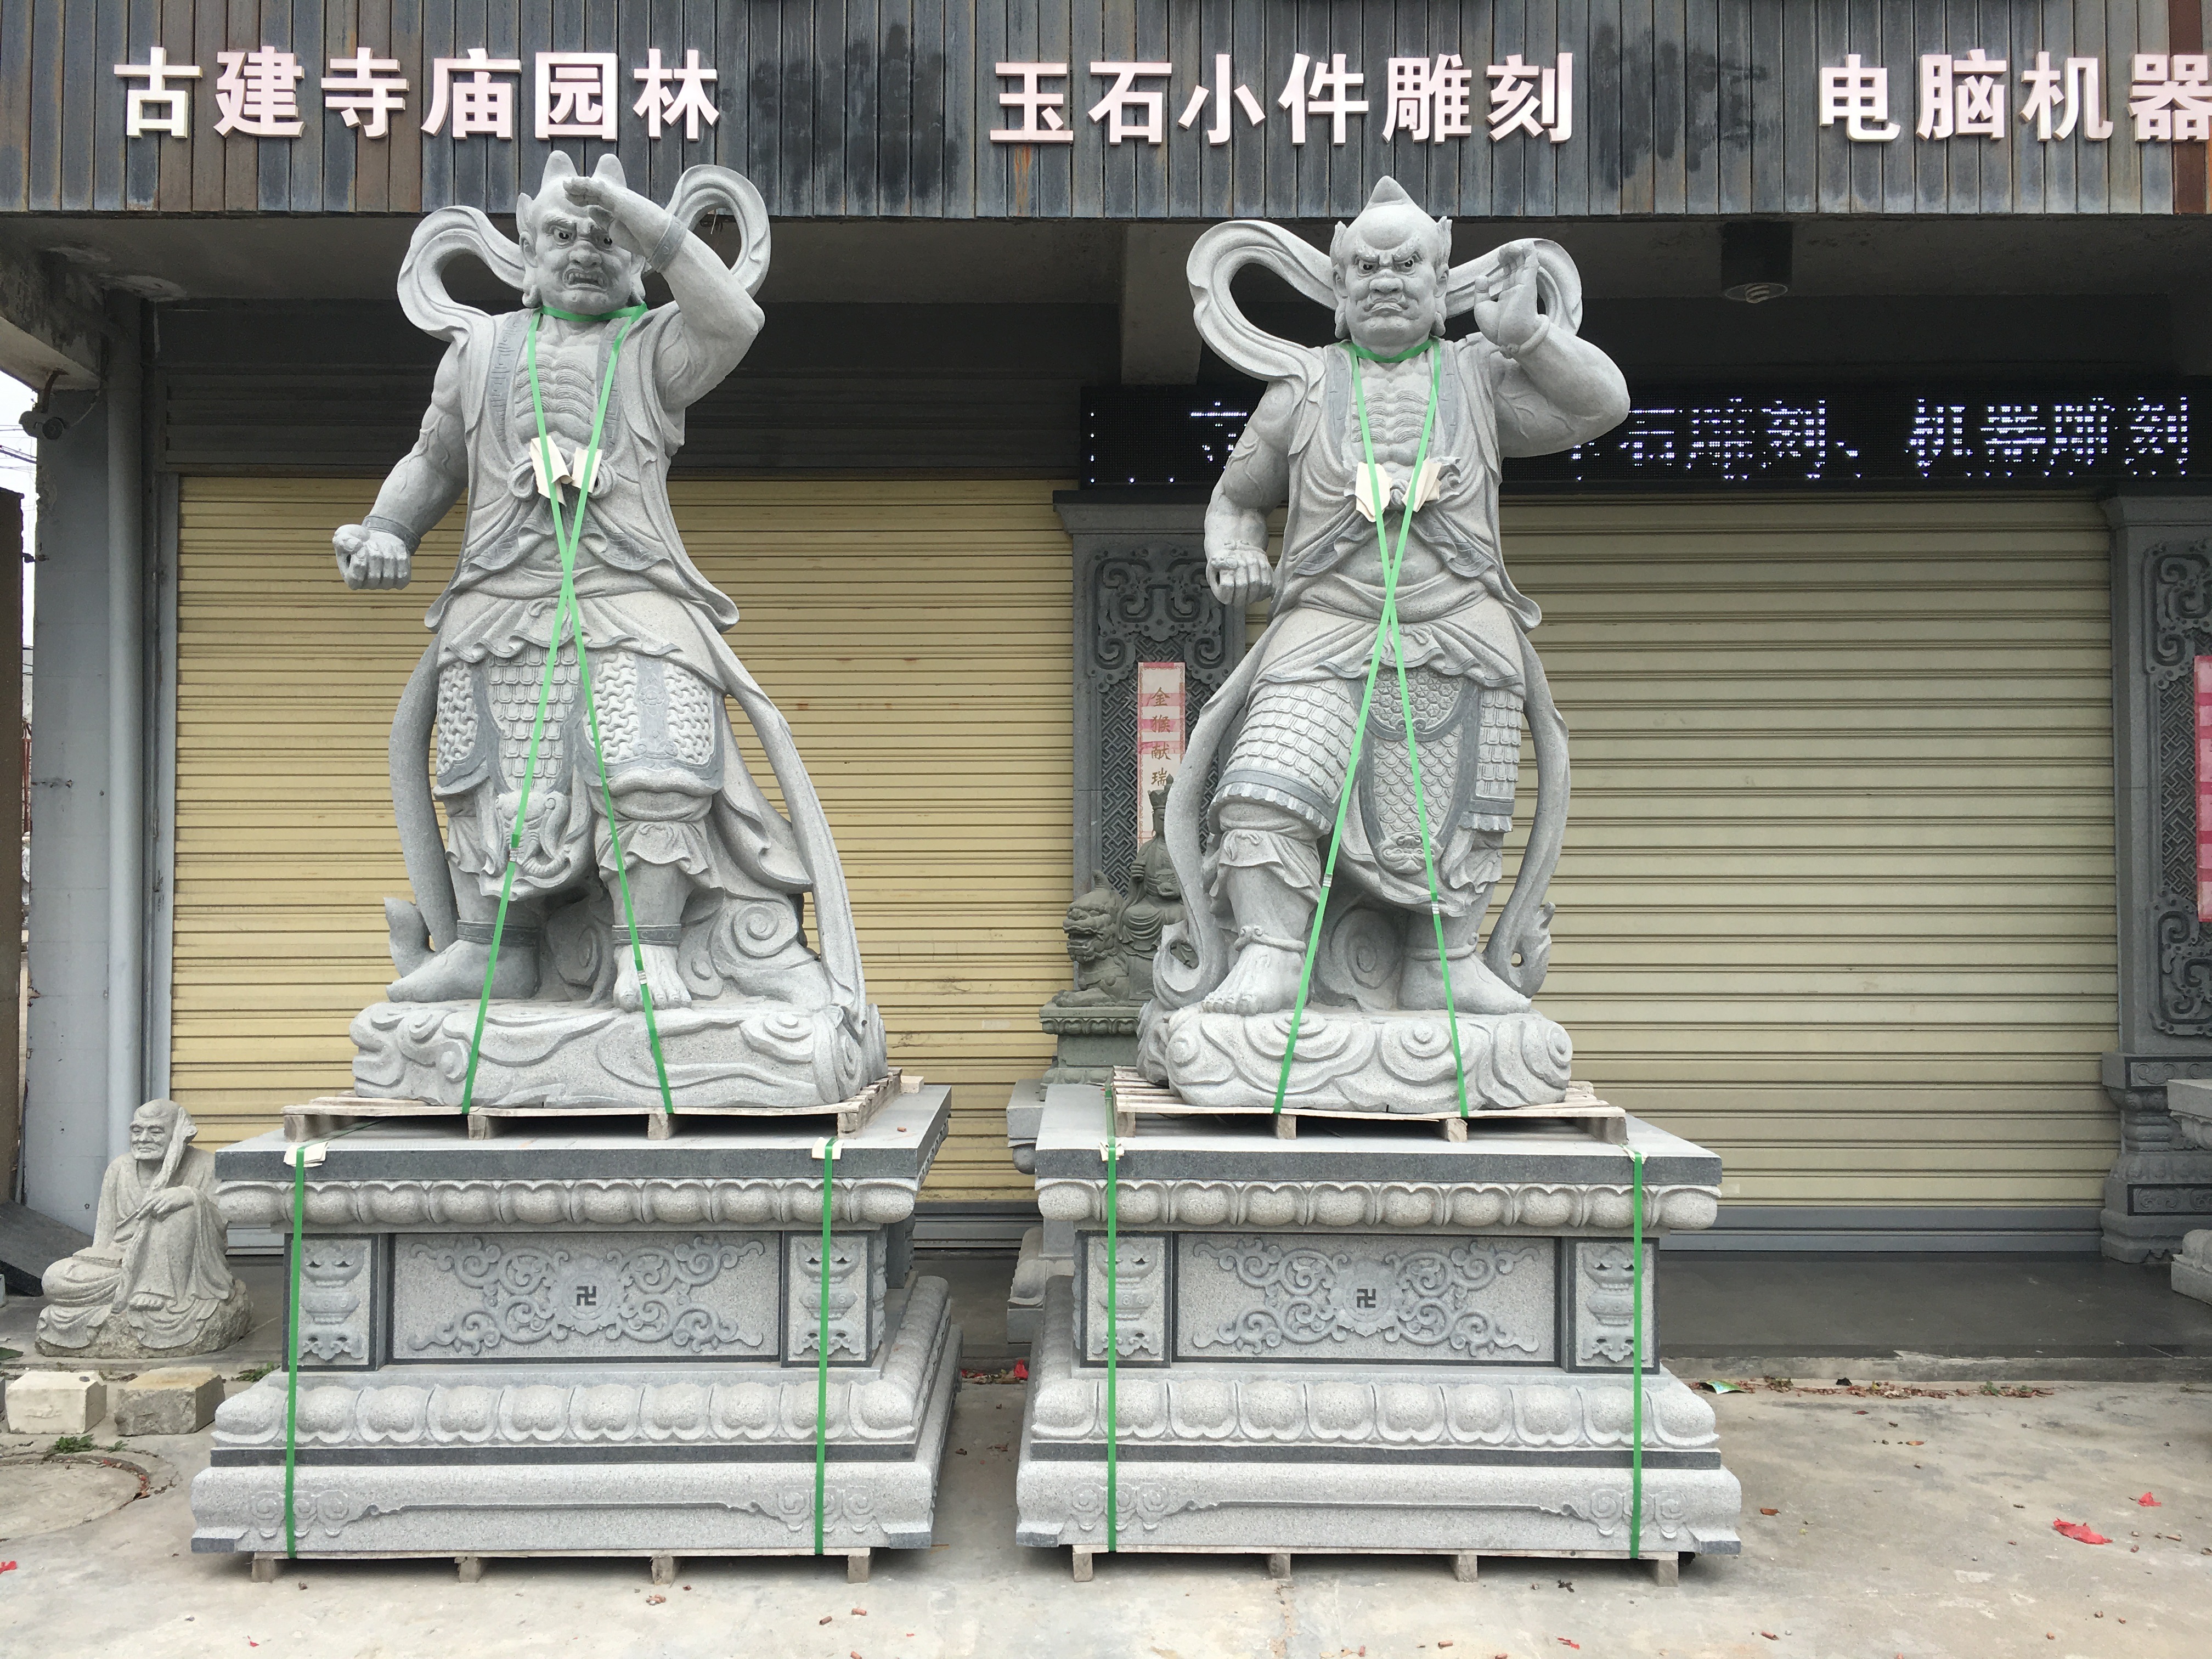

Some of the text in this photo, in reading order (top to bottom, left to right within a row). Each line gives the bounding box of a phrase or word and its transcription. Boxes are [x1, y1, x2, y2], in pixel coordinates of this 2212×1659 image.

[114, 46, 2212, 145] 古建寺庙园林 玉石小件雕刻 电脑机器
[1571, 396, 2188, 478] 石雕刻、机器雕刻
[1151, 687, 1171, 786] 金猴献瑞
